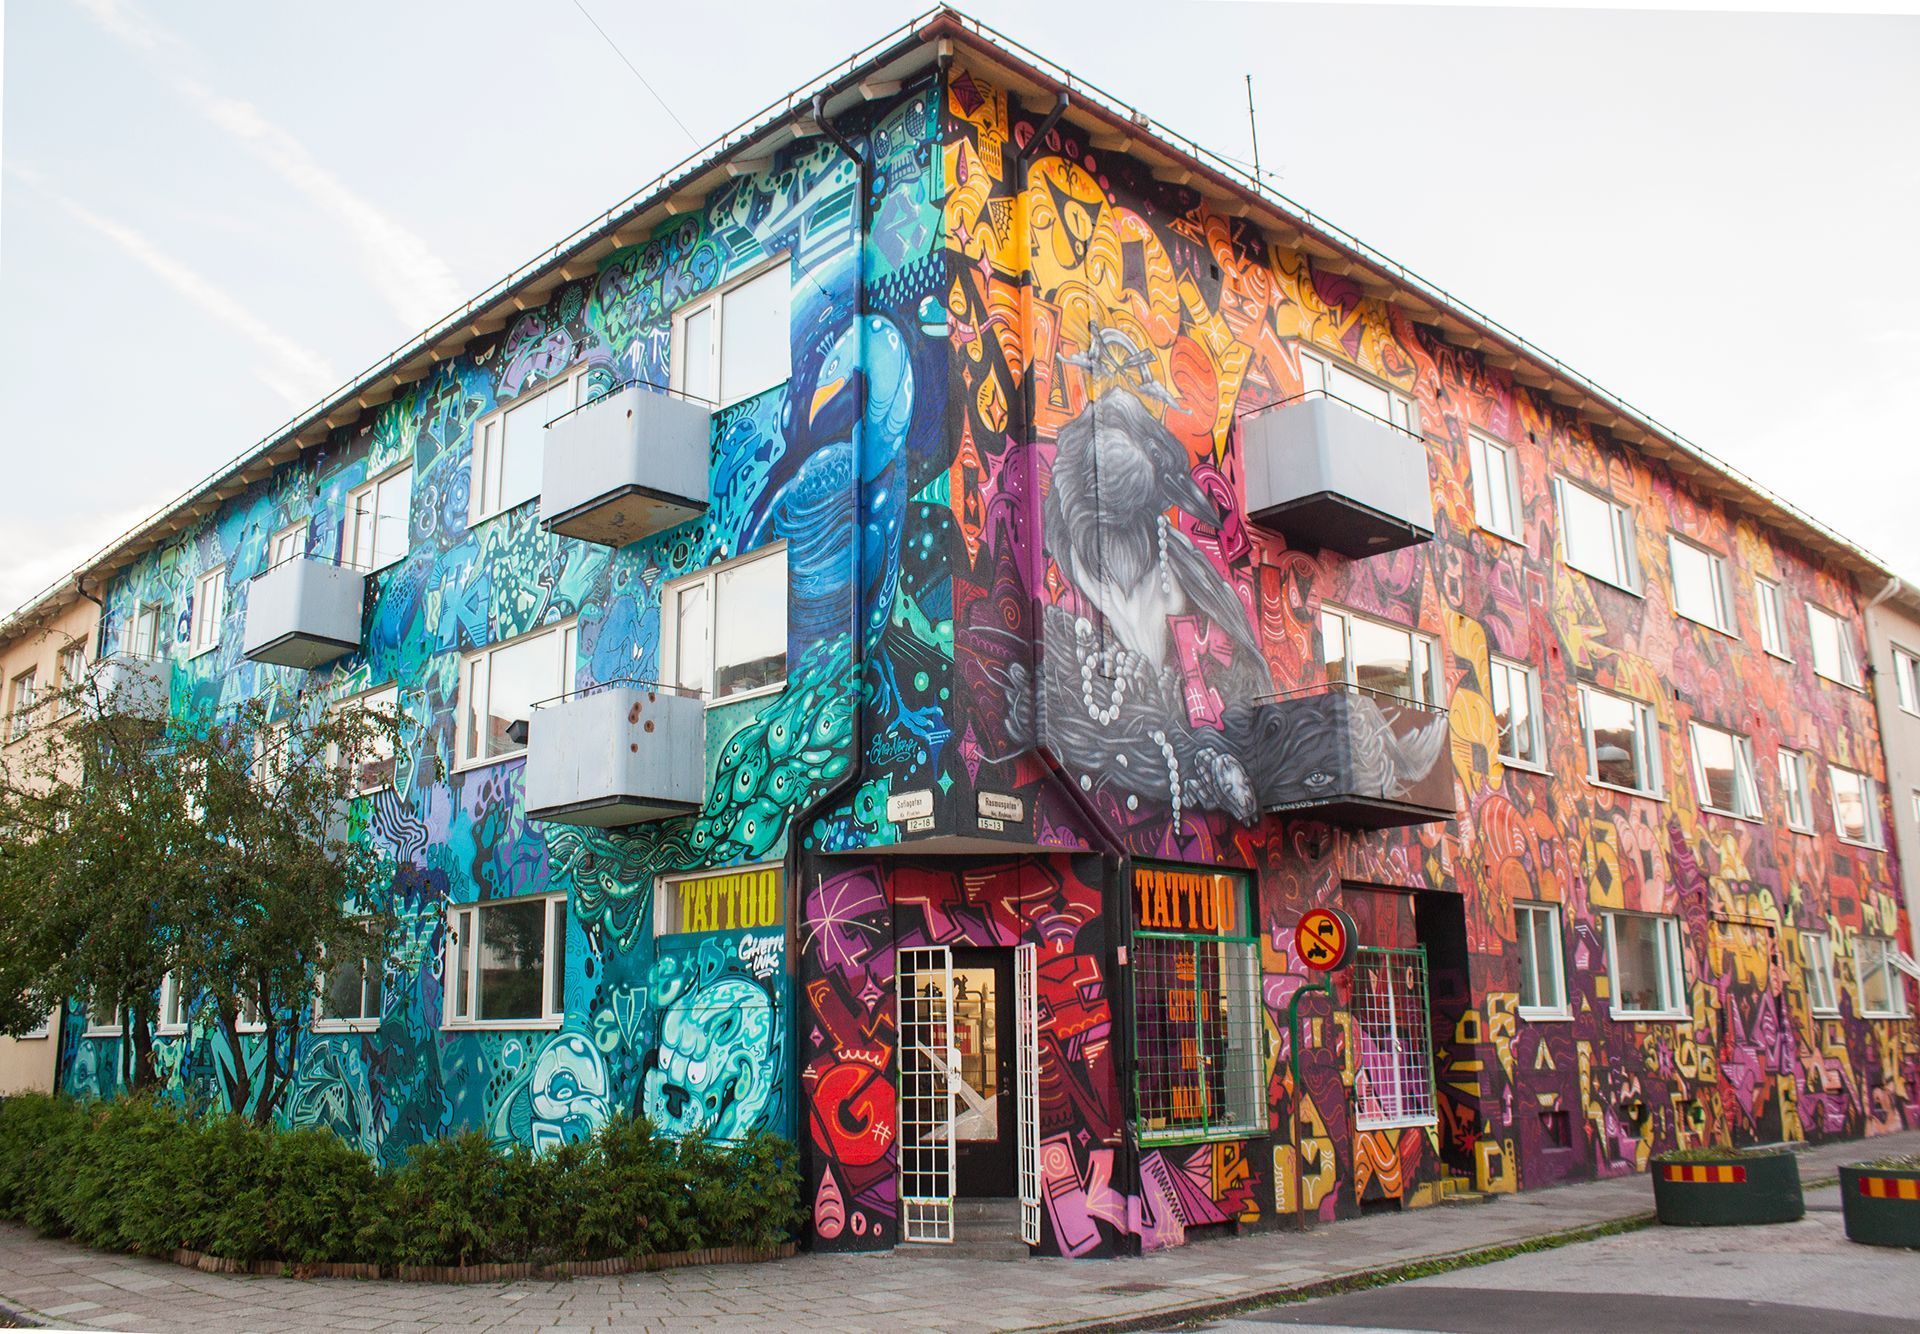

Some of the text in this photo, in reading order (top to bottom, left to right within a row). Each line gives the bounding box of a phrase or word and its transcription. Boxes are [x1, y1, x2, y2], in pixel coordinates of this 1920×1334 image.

[909, 818, 931, 830] 12-18
[980, 819, 1002, 830] 15-13
[679, 870, 777, 934] TATTOO
[1135, 868, 1235, 931] TATTOO
